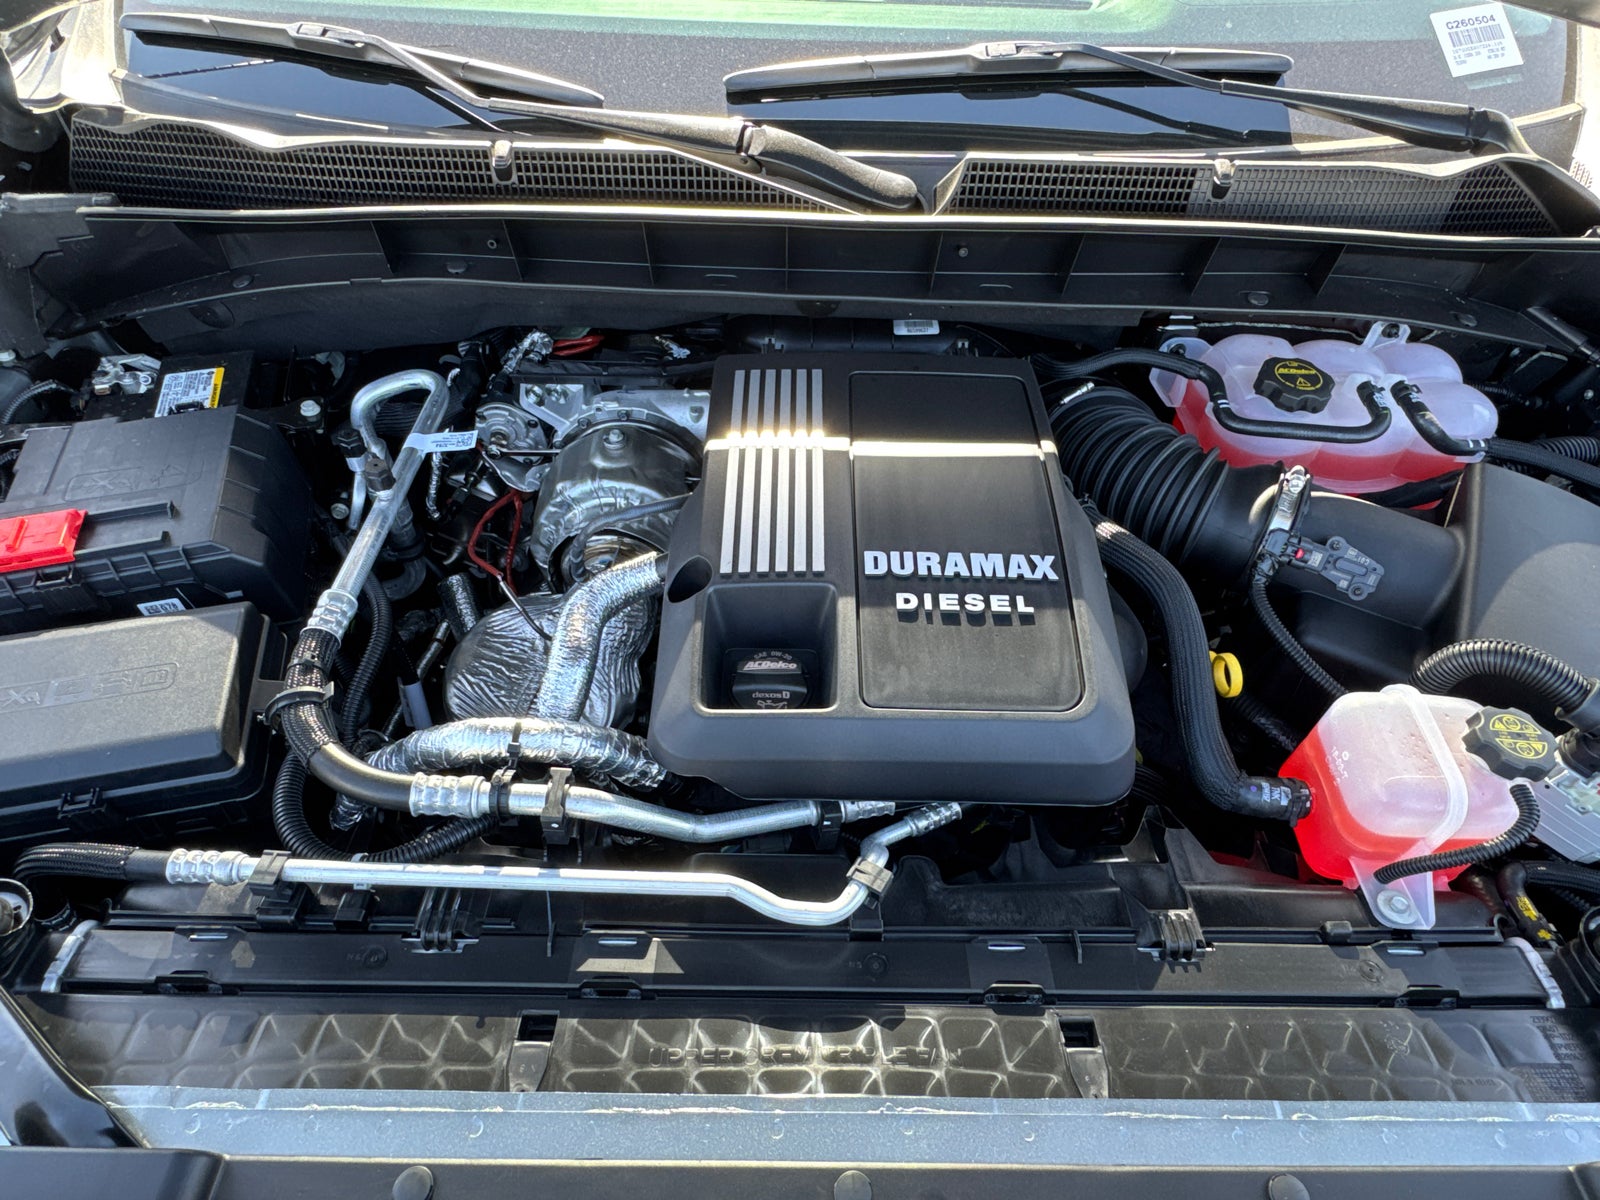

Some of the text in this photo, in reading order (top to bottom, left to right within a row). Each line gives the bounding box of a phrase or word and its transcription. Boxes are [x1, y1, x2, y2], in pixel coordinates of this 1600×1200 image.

[864, 551, 1059, 580] DURAMAX
[896, 593, 1034, 613] DIESEL
[743, 661, 797, 670] ACDelco
[649, 1047, 734, 1068] UPPER
